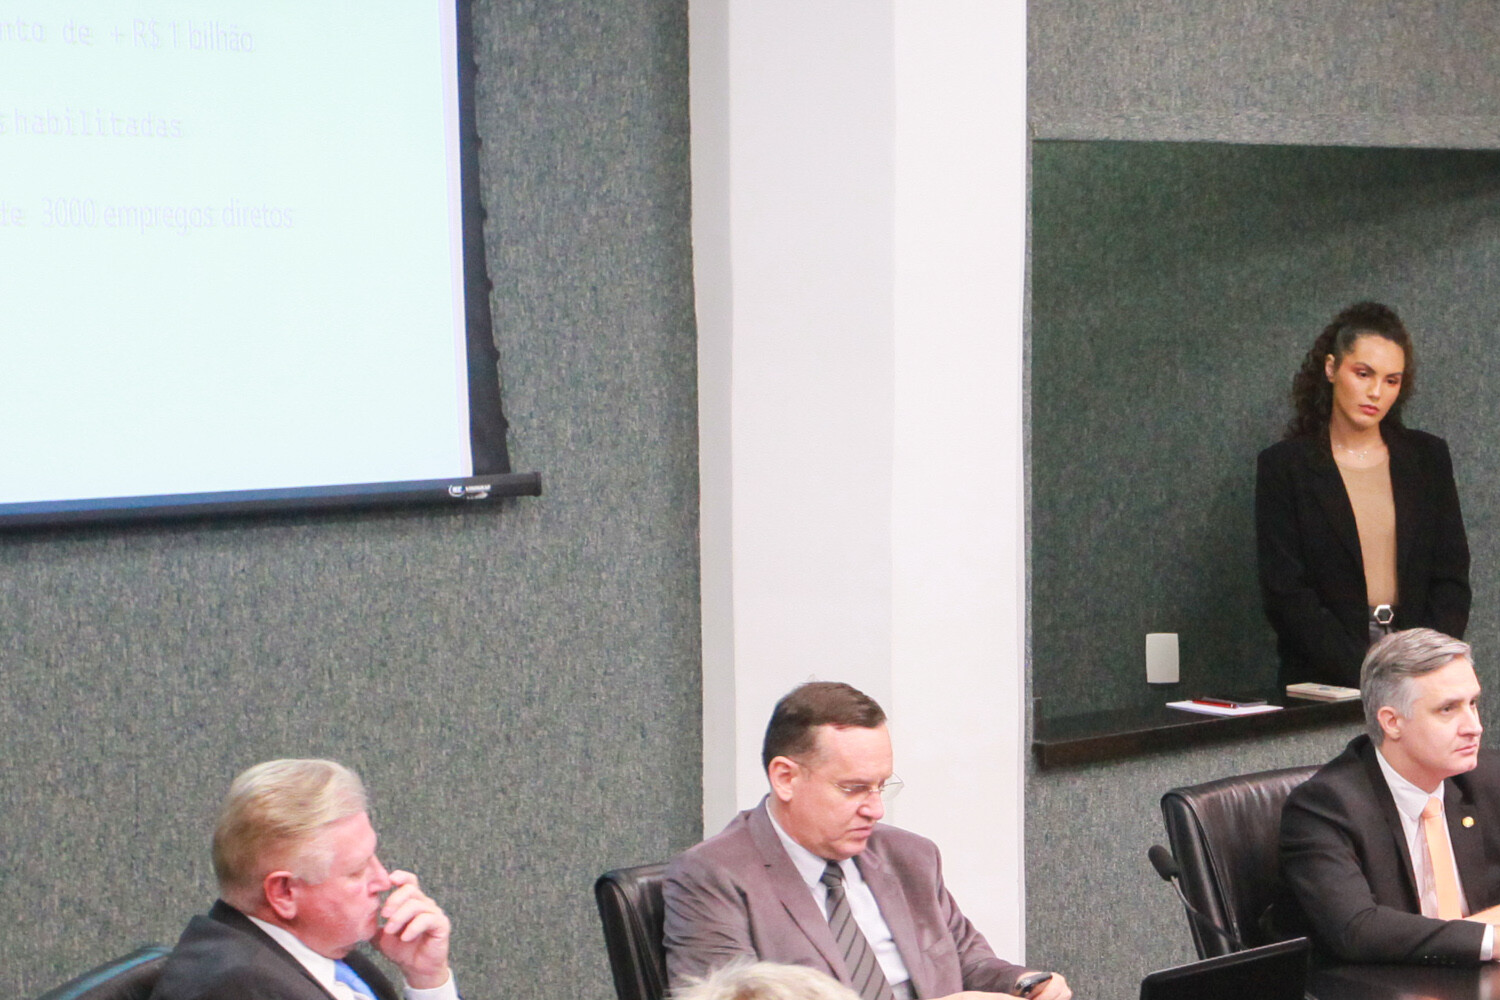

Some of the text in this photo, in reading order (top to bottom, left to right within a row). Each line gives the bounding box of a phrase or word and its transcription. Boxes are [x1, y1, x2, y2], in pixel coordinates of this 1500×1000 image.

[62, 19, 91, 45] de
[133, 17, 160, 50] R$
[168, 20, 178, 48] 1
[188, 19, 254, 53] bilhão
[14, 107, 183, 138] habilitadas
[41, 196, 96, 228] 3000
[103, 203, 214, 236] empregos
[222, 198, 293, 229] diretos
